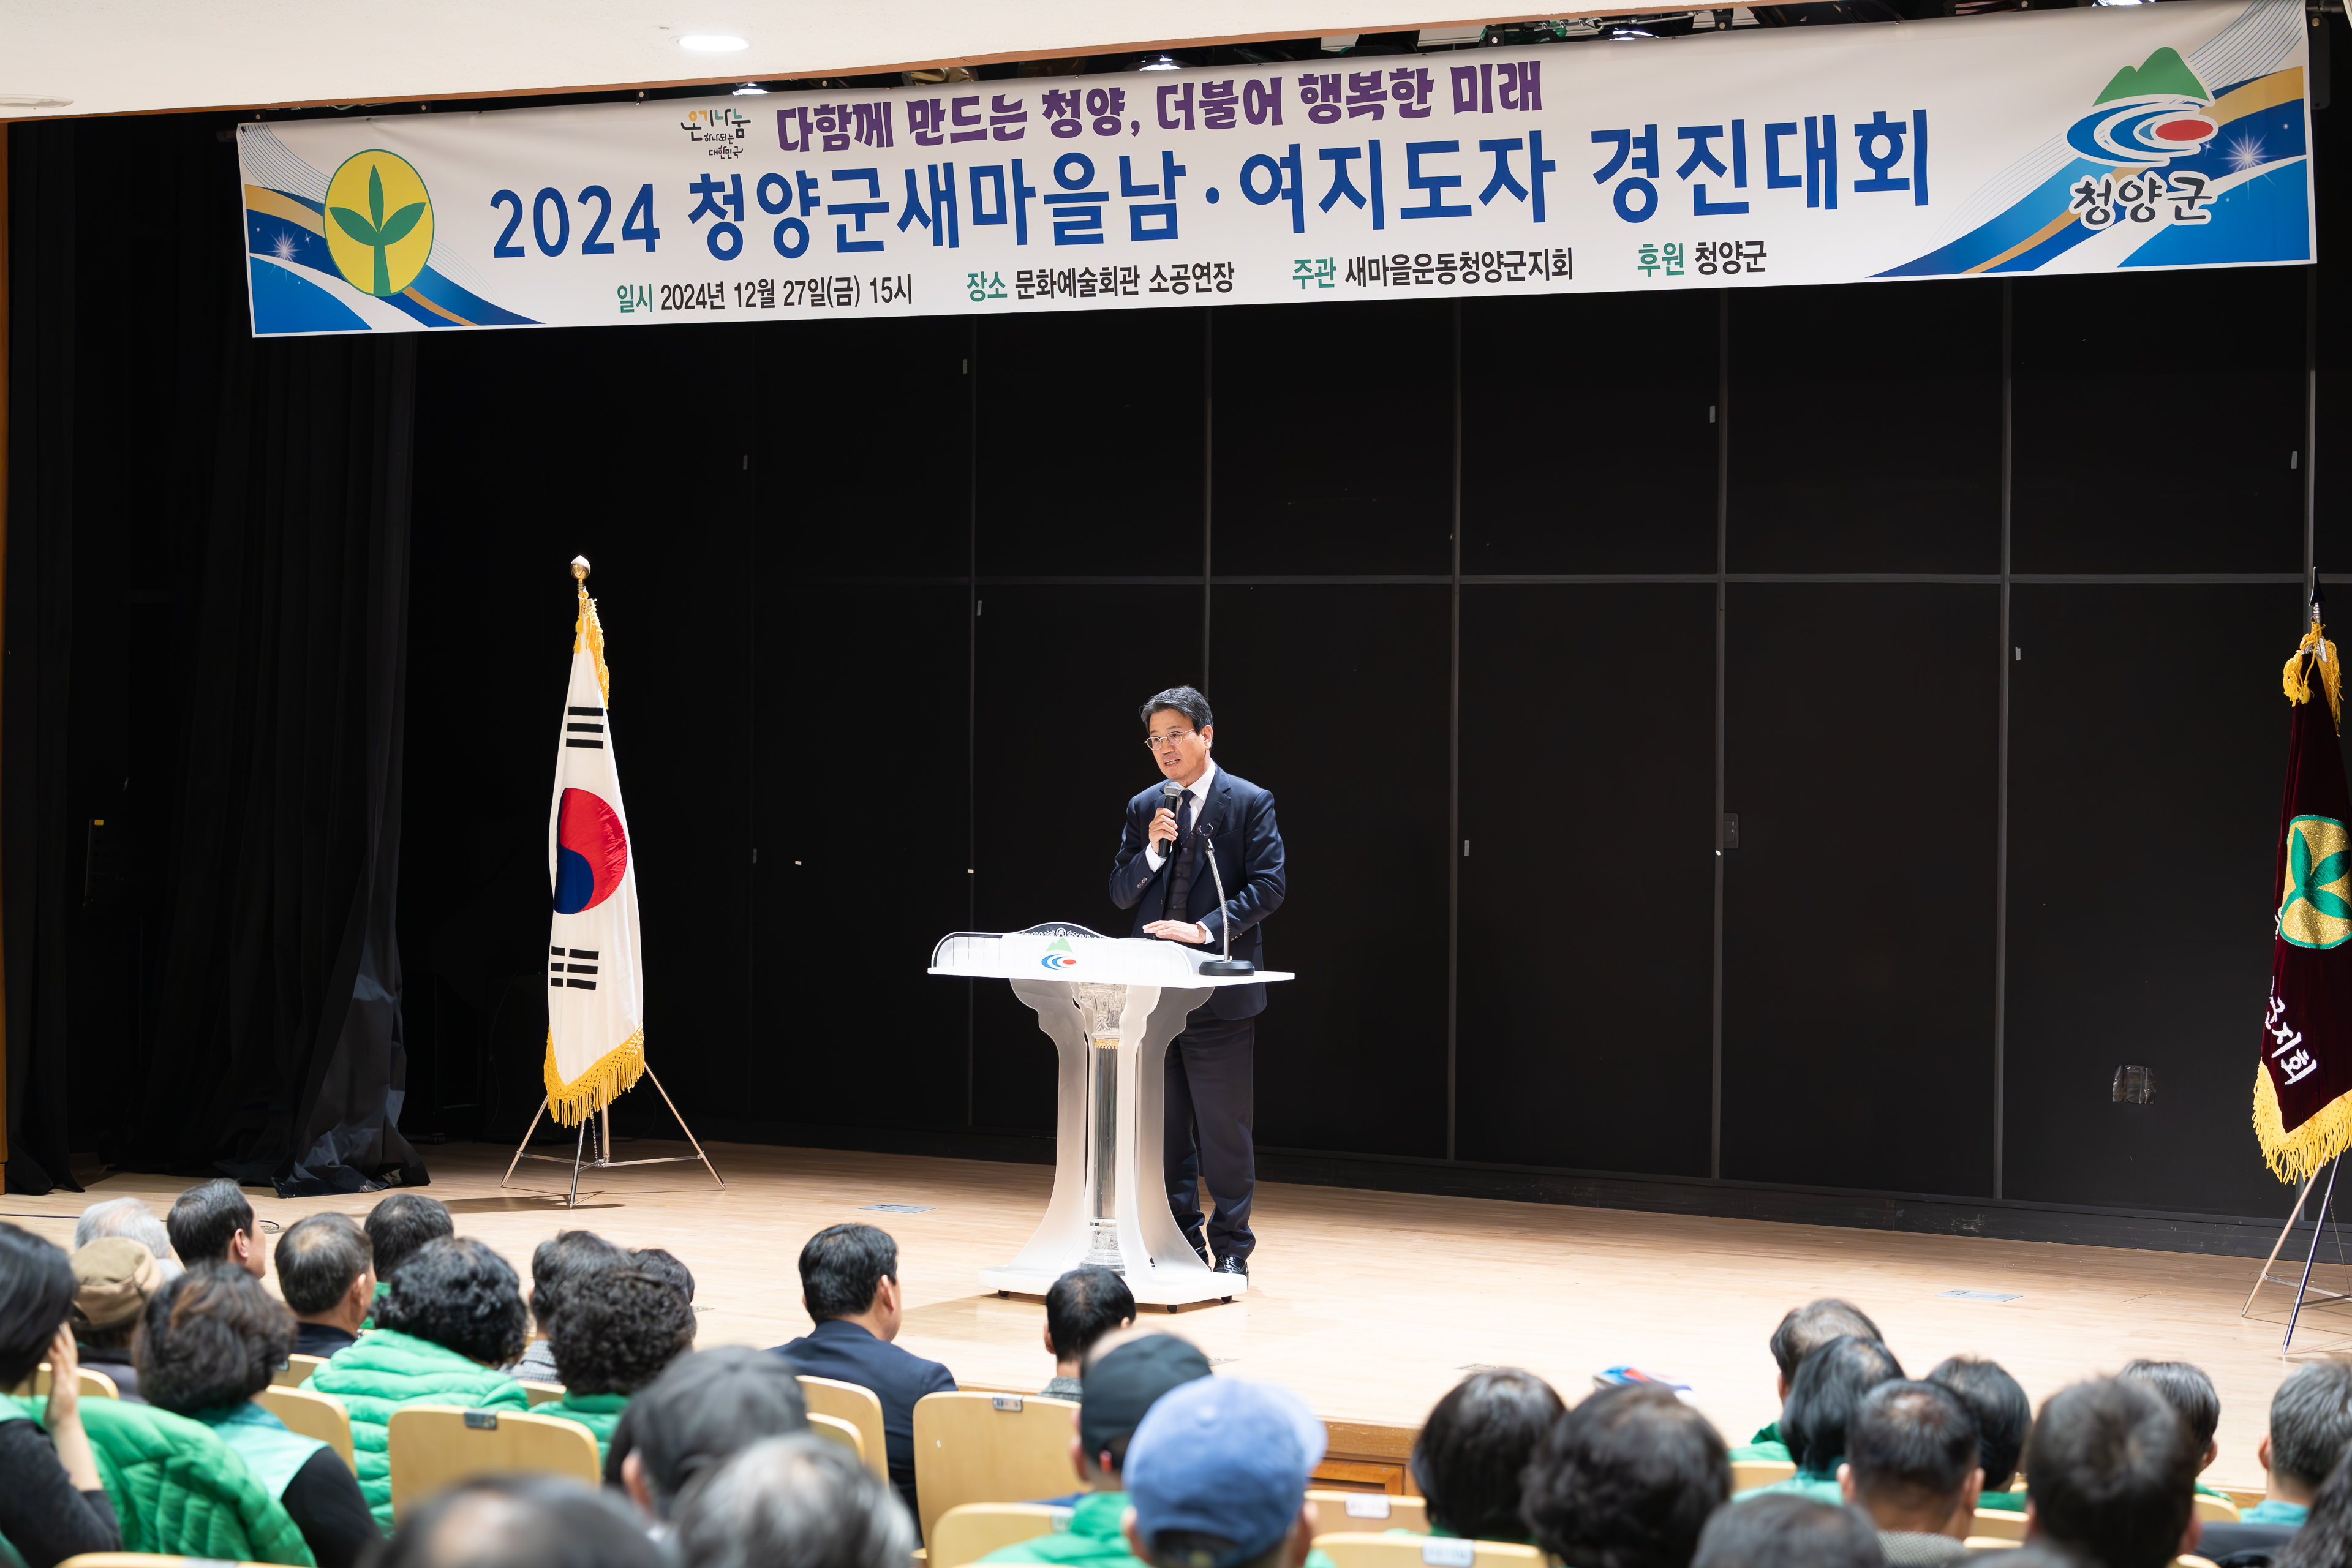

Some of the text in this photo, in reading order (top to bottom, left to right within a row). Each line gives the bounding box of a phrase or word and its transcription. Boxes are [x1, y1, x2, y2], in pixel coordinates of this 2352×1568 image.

[777, 61, 1542, 153] 다함께 만드는 청양, 더불어 행복한 미래
[704, 133, 735, 144] 하나되는
[709, 145, 744, 160] 대한민국
[490, 184, 661, 258] 2024
[1591, 109, 1929, 224] 경진대회
[2073, 176, 2213, 225] 청양군
[1292, 247, 1573, 290] 주관 새마을운동청양군지회
[1637, 240, 1767, 277] 후원 청양군
[617, 274, 912, 314] 일시 2024년 12월 27일(금) 15시
[967, 261, 1235, 302] 장소 문화예술회관 소공연장
[2265, 976, 2317, 1085] 군지회
